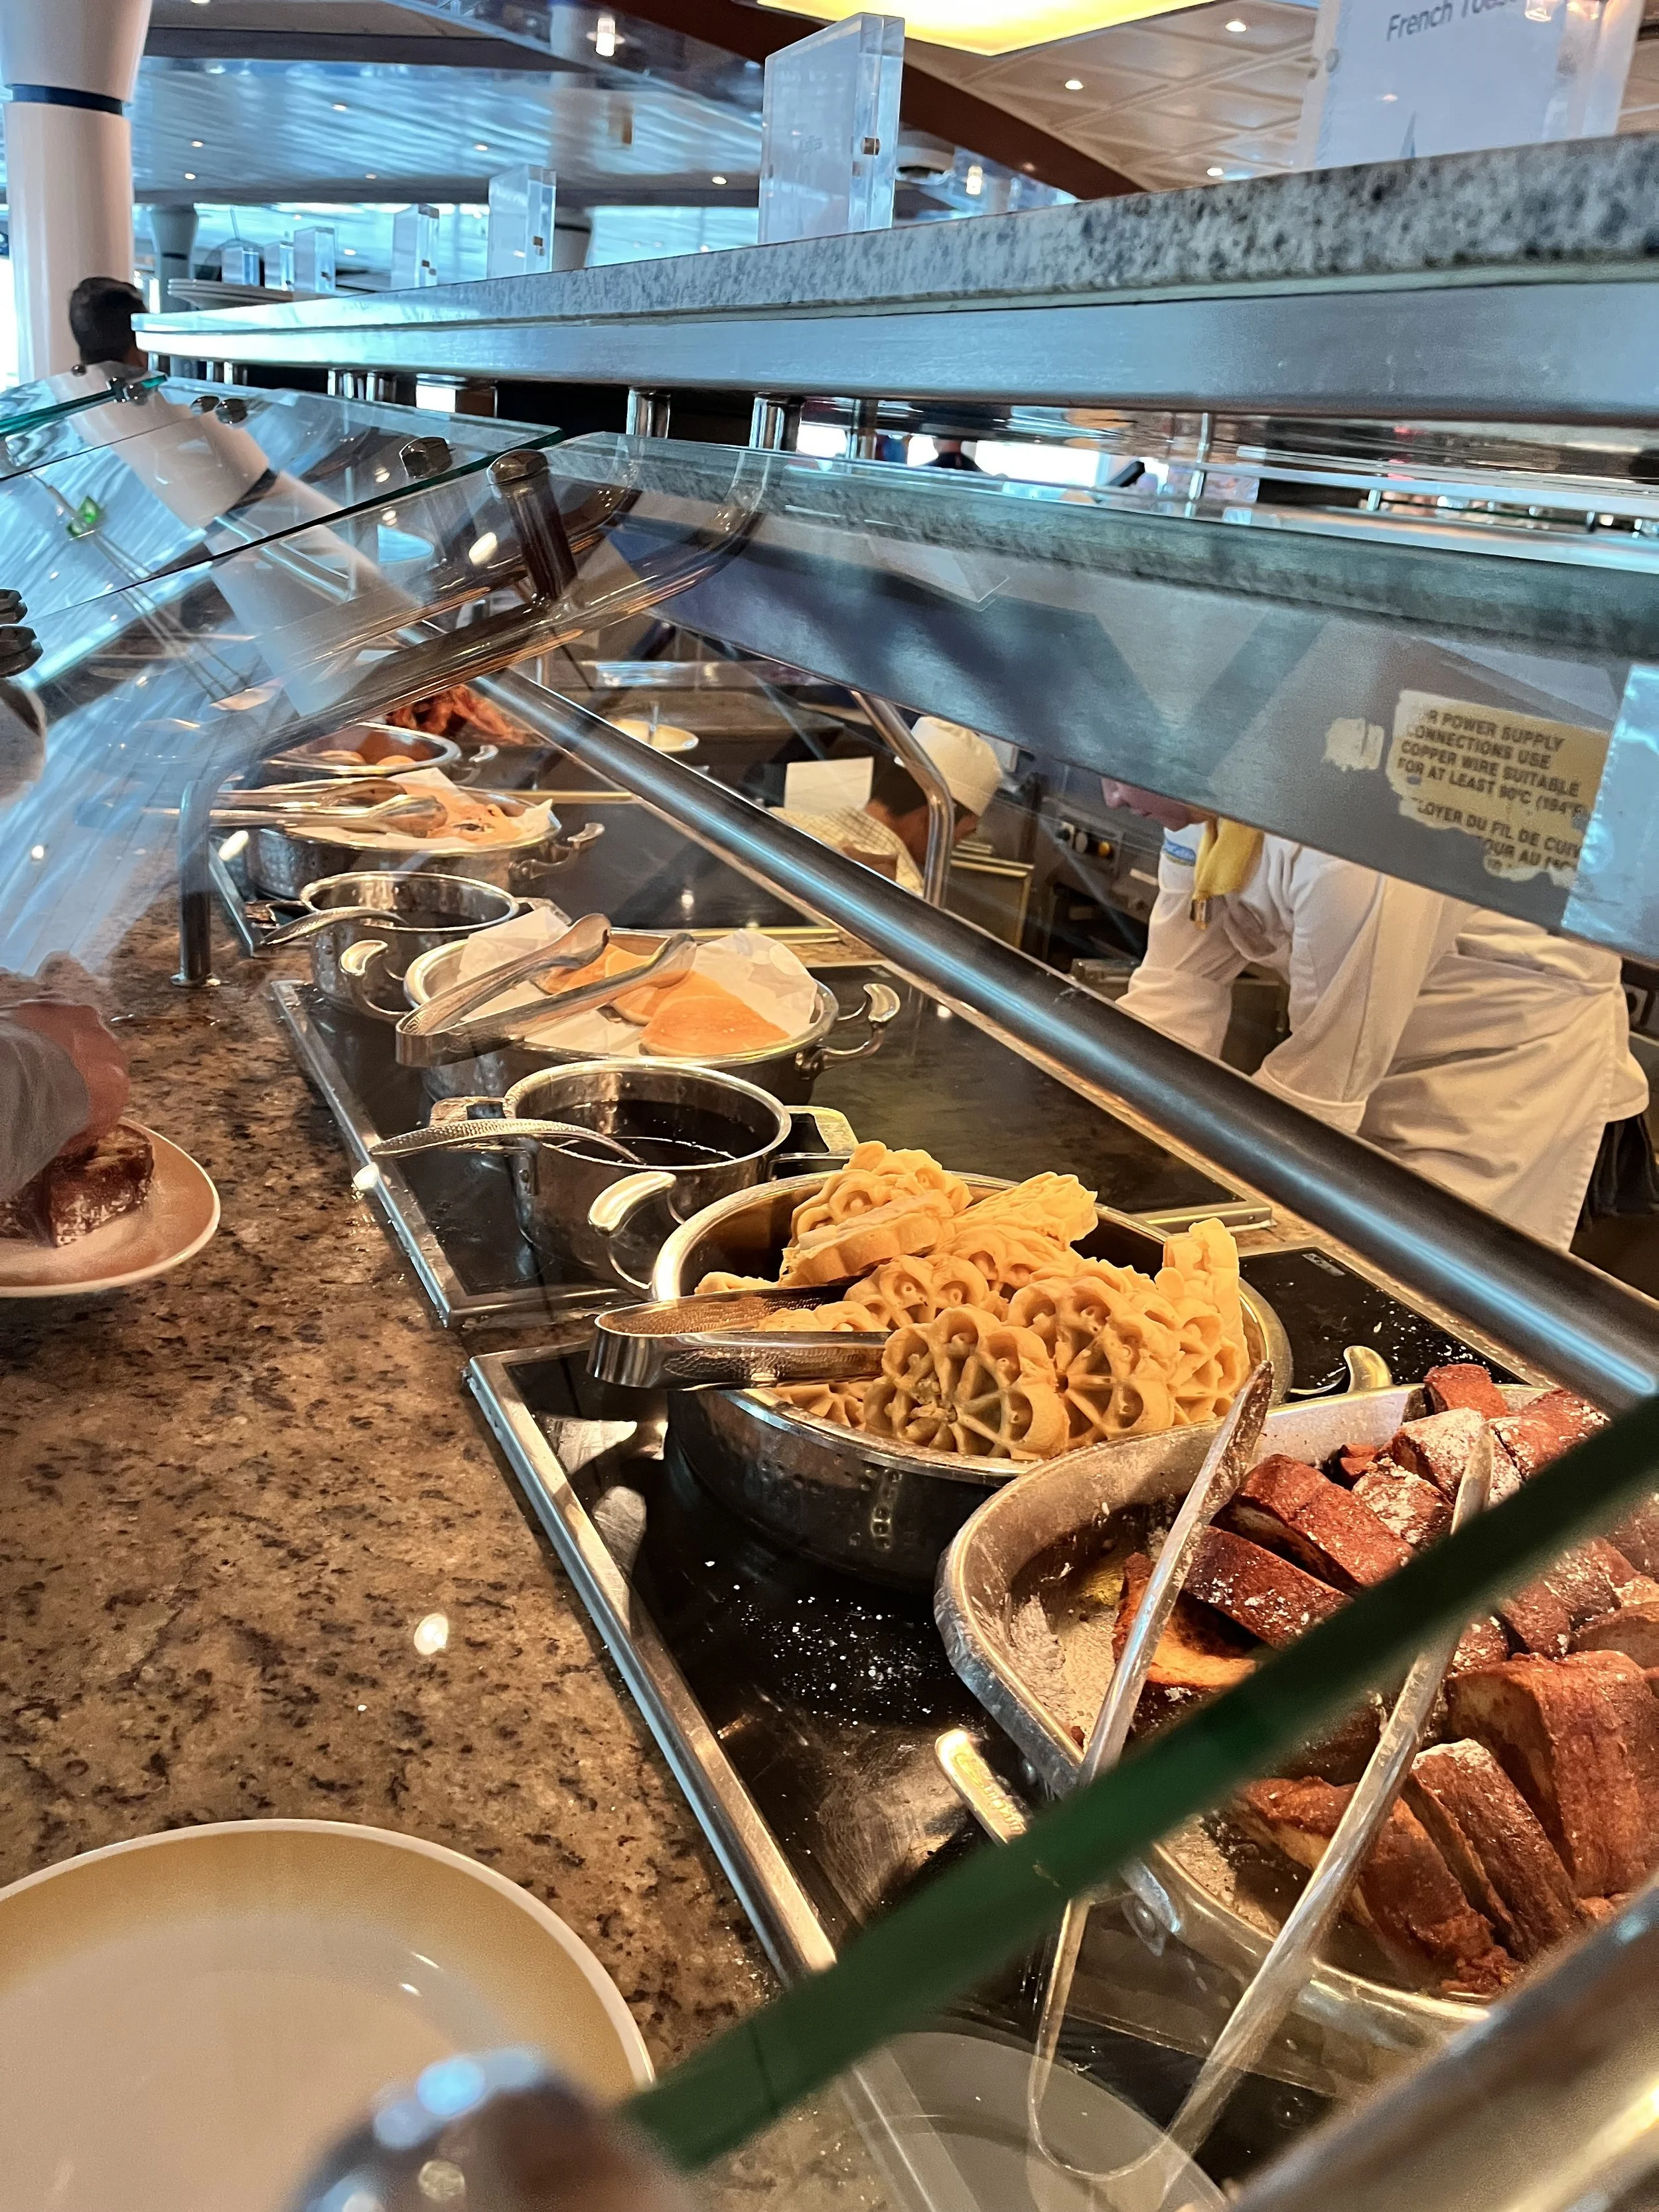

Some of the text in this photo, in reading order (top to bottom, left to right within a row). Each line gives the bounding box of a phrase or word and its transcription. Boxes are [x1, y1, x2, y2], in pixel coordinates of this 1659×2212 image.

[1386, 0, 1453, 41] French
[1442, 712, 1497, 739] POWER
[1502, 726, 1565, 752] SUPPLY
[1398, 757, 1424, 774] FOR
[1428, 765, 1446, 780] AT
[1449, 770, 1496, 794] LEAST
[1402, 740, 1580, 797] COPPER WIRE SUITABLE
[1518, 749, 1551, 770] USE
[1466, 814, 1488, 831] DU
[1491, 820, 1514, 840] FIL
[1518, 828, 1540, 846] DE
[1518, 849, 1542, 866] AU
